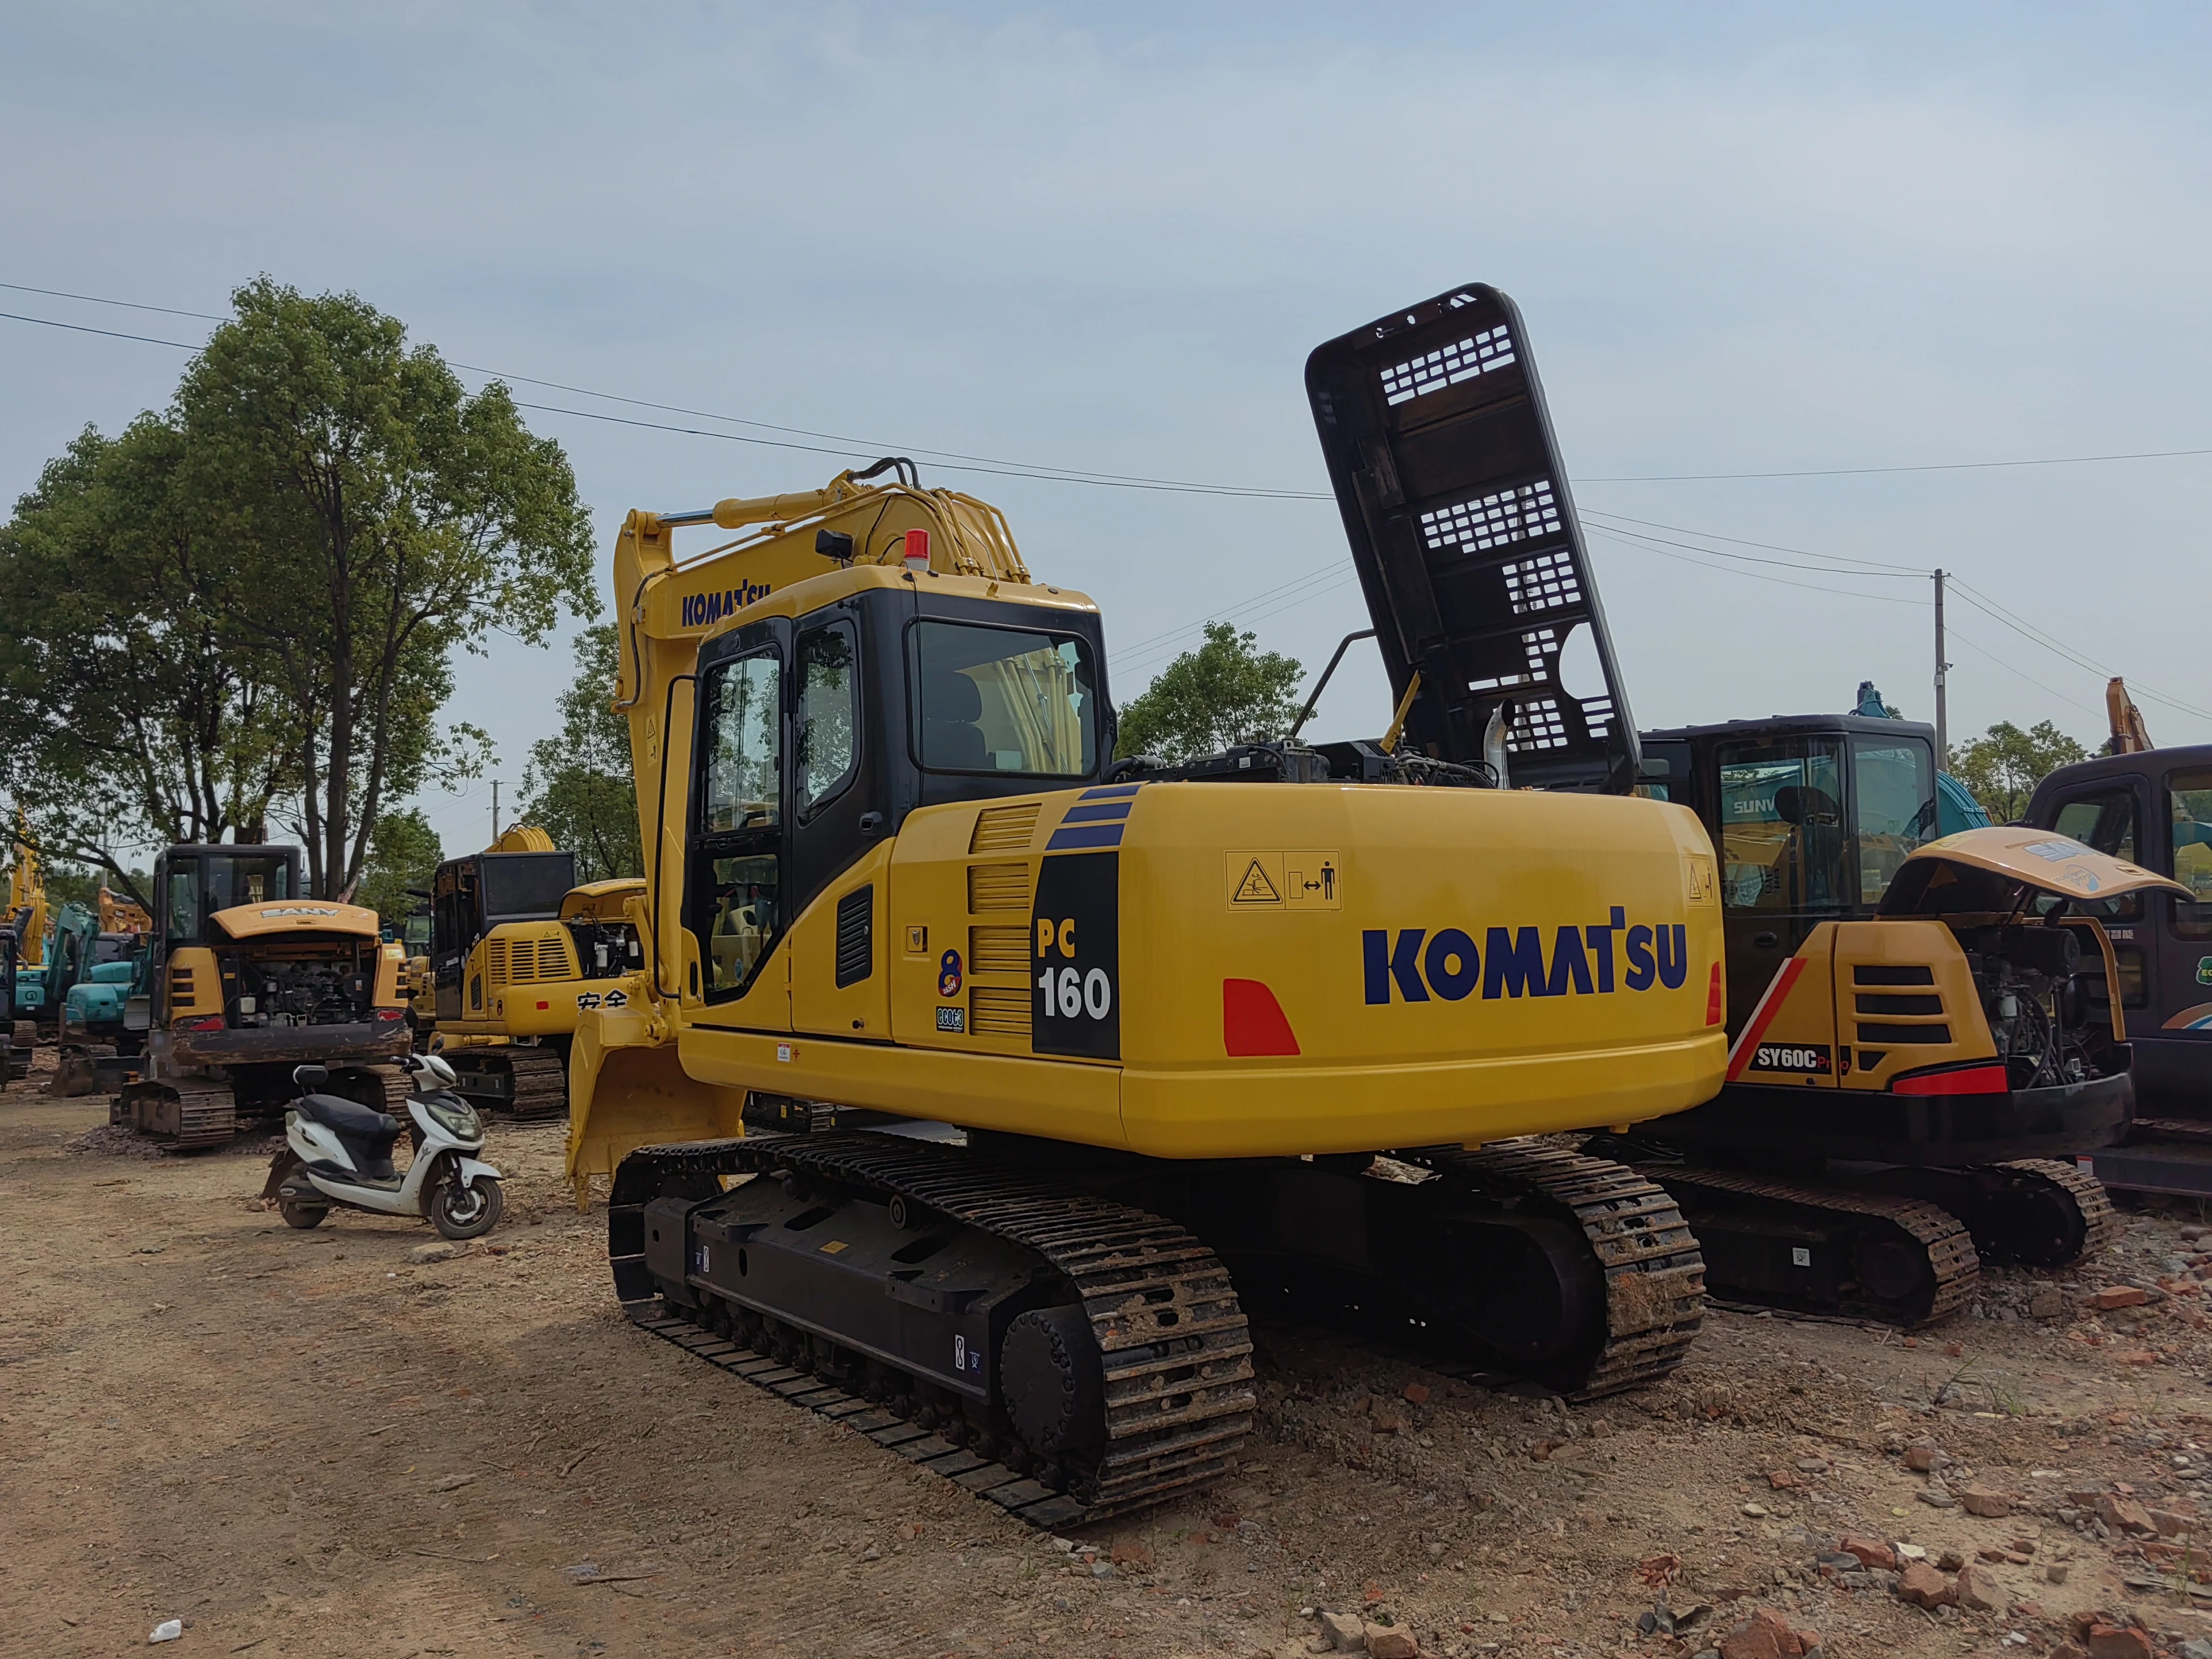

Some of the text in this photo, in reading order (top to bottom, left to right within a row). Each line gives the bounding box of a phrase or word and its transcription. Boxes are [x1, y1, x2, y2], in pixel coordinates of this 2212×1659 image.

[260, 908, 340, 918] SANY
[1037, 918, 1075, 958] PC
[939, 949, 962, 997] 8
[1361, 906, 1688, 1006] KOMATSU
[577, 988, 628, 1016] 安全
[1038, 967, 1110, 1020] 160
[937, 1008, 963, 1027] ecot3
[1758, 1048, 1849, 1070] SY60C Pro
